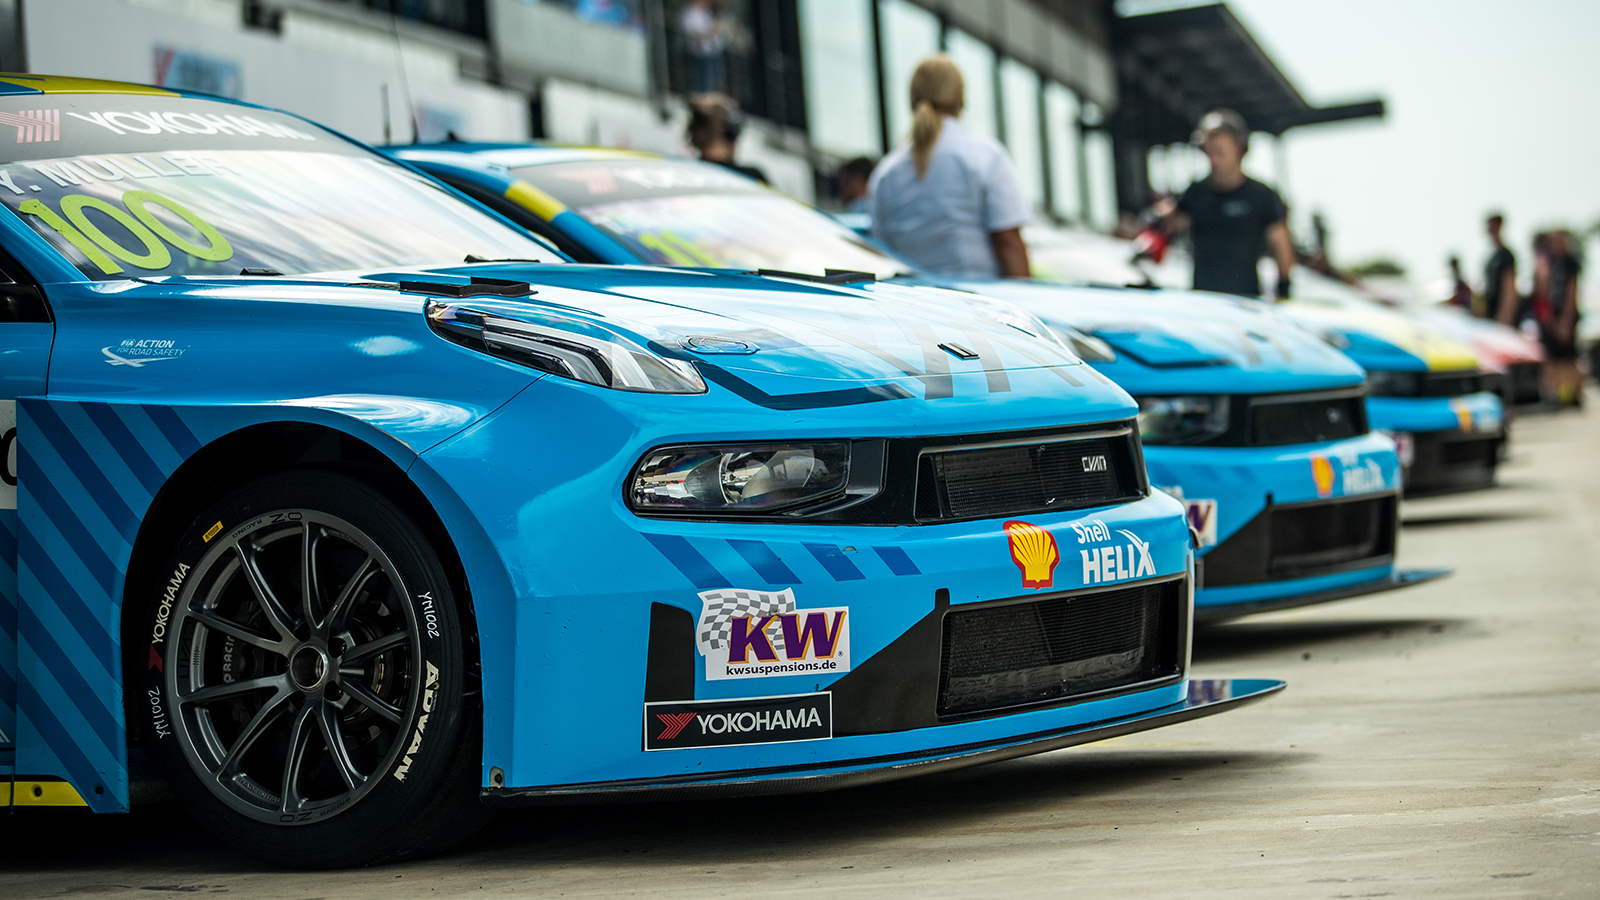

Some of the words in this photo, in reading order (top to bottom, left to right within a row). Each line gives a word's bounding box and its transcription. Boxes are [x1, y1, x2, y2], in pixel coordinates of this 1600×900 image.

[31, 154, 243, 188] MULLER
[18, 189, 235, 276] 100
[128, 347, 153, 356] ROAD
[152, 347, 187, 357] SAFETY
[134, 339, 176, 349] ACTION
[1070, 518, 1112, 545] Shell
[1079, 528, 1158, 585] HELIX
[151, 562, 191, 645] YOKOHAMA
[726, 610, 848, 665] KW
[725, 659, 838, 676] kwsuspensions.de
[392, 659, 440, 784] ADVAN
[696, 706, 823, 735] YOKOHAMA
